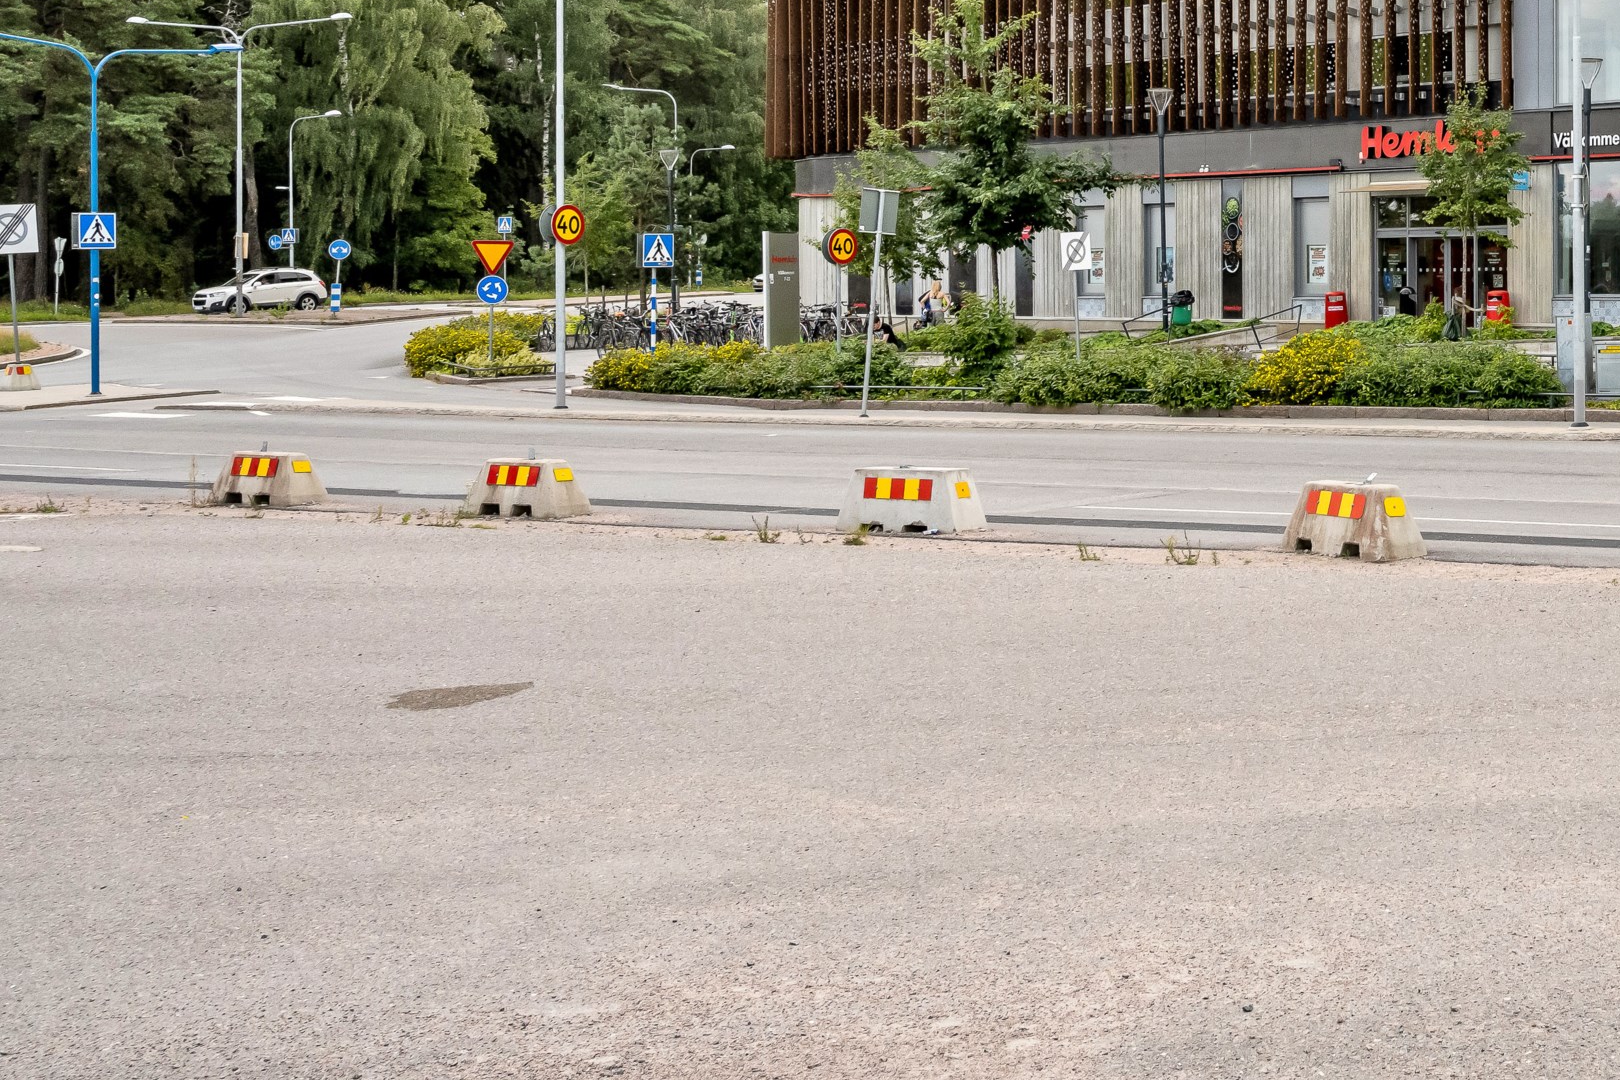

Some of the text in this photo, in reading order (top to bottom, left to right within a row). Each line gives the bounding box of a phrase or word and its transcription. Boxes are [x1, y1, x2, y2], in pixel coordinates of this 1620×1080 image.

[1360, 119, 1500, 160] Hemk
[556, 214, 581, 235] 40
[832, 237, 853, 255] 40
